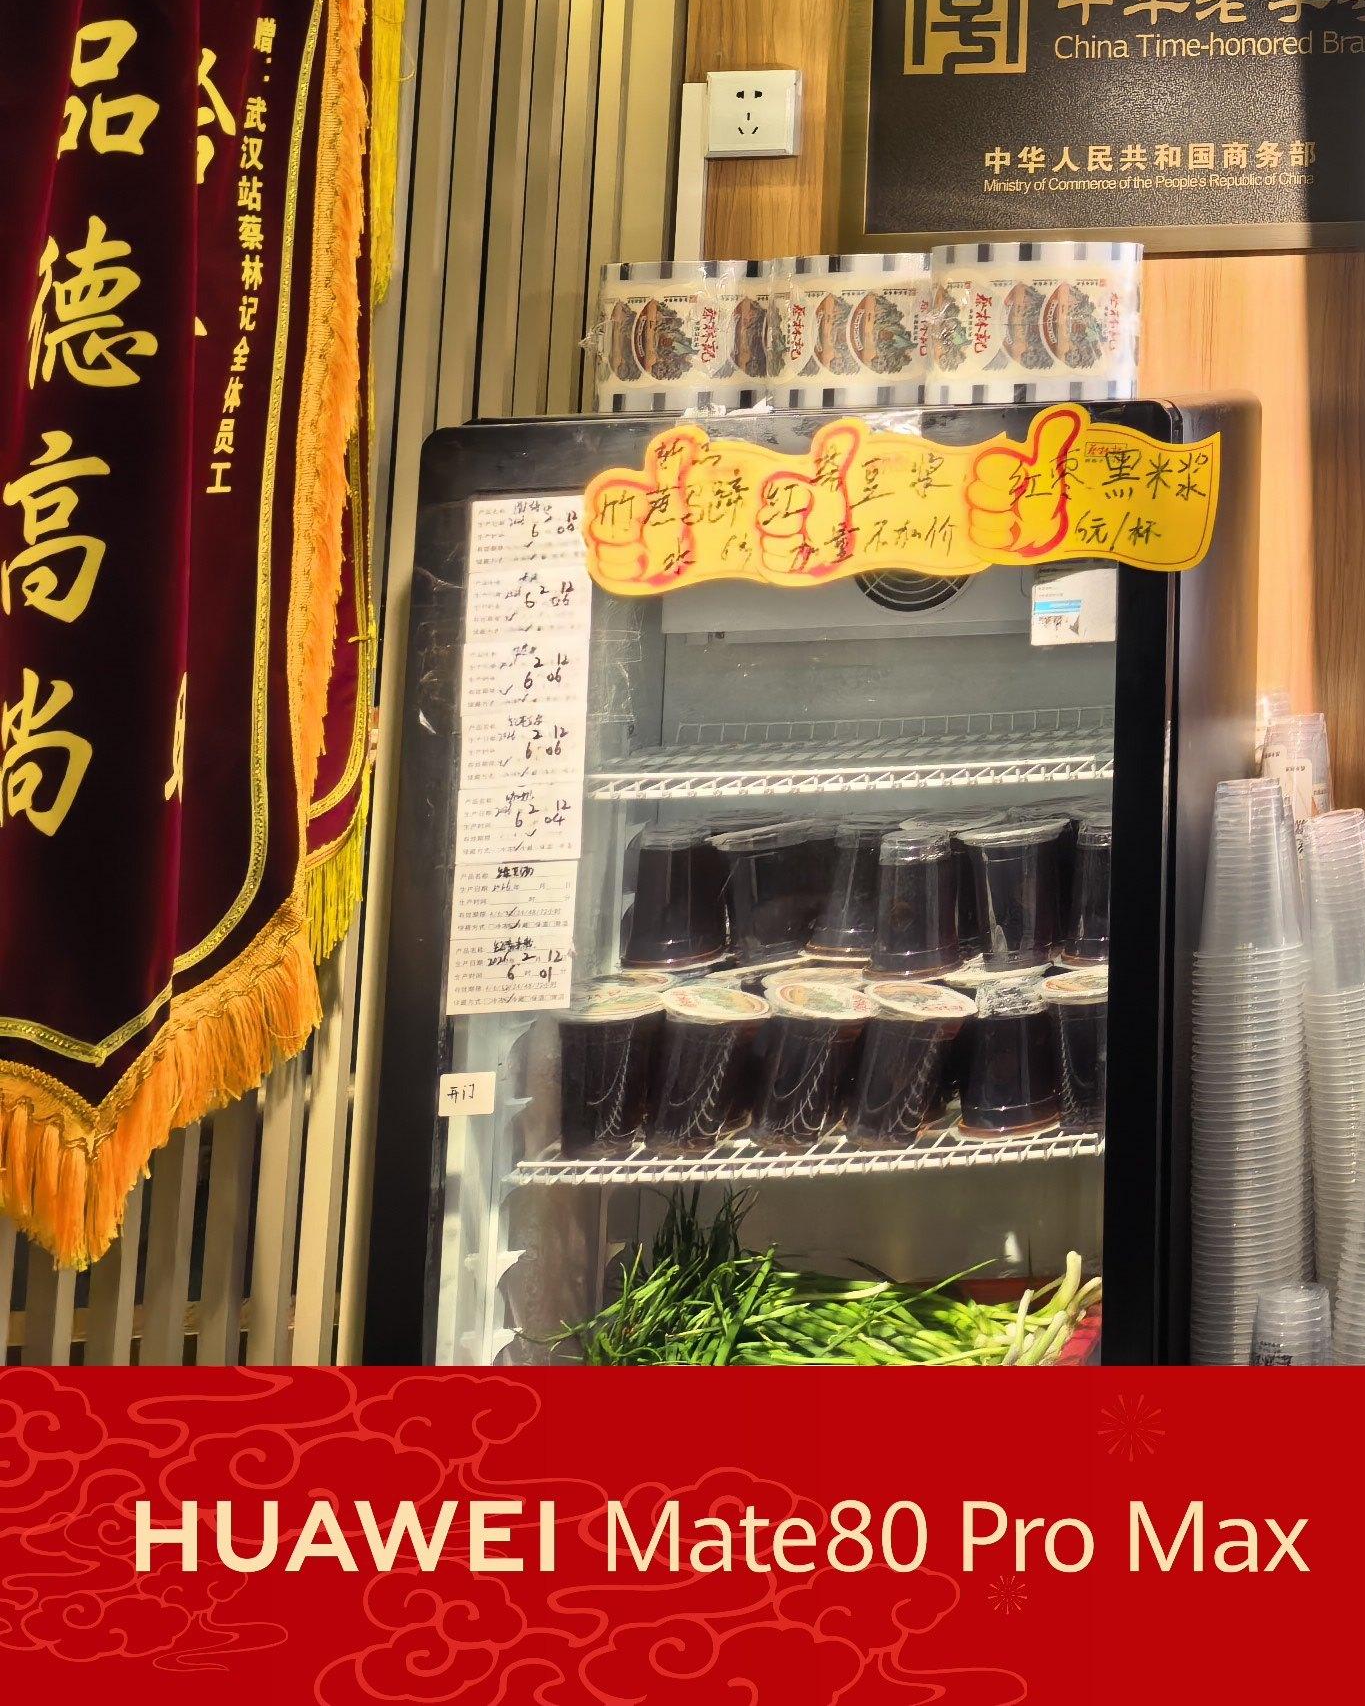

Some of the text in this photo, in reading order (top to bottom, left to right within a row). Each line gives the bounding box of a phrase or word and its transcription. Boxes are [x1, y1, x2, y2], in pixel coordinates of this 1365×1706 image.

[1055, 30, 1313, 60] China Time-honored
[985, 141, 1317, 175] 中华人民共和国商务部
[984, 179, 1031, 195] Ministry
[1034, 178, 1047, 192] of
[1049, 176, 1116, 191] Commerce
[1209, 173, 1262, 189] Republic
[1265, 173, 1277, 187] of
[1280, 171, 1314, 187] China
[0, 20, 160, 836] 品德高尚
